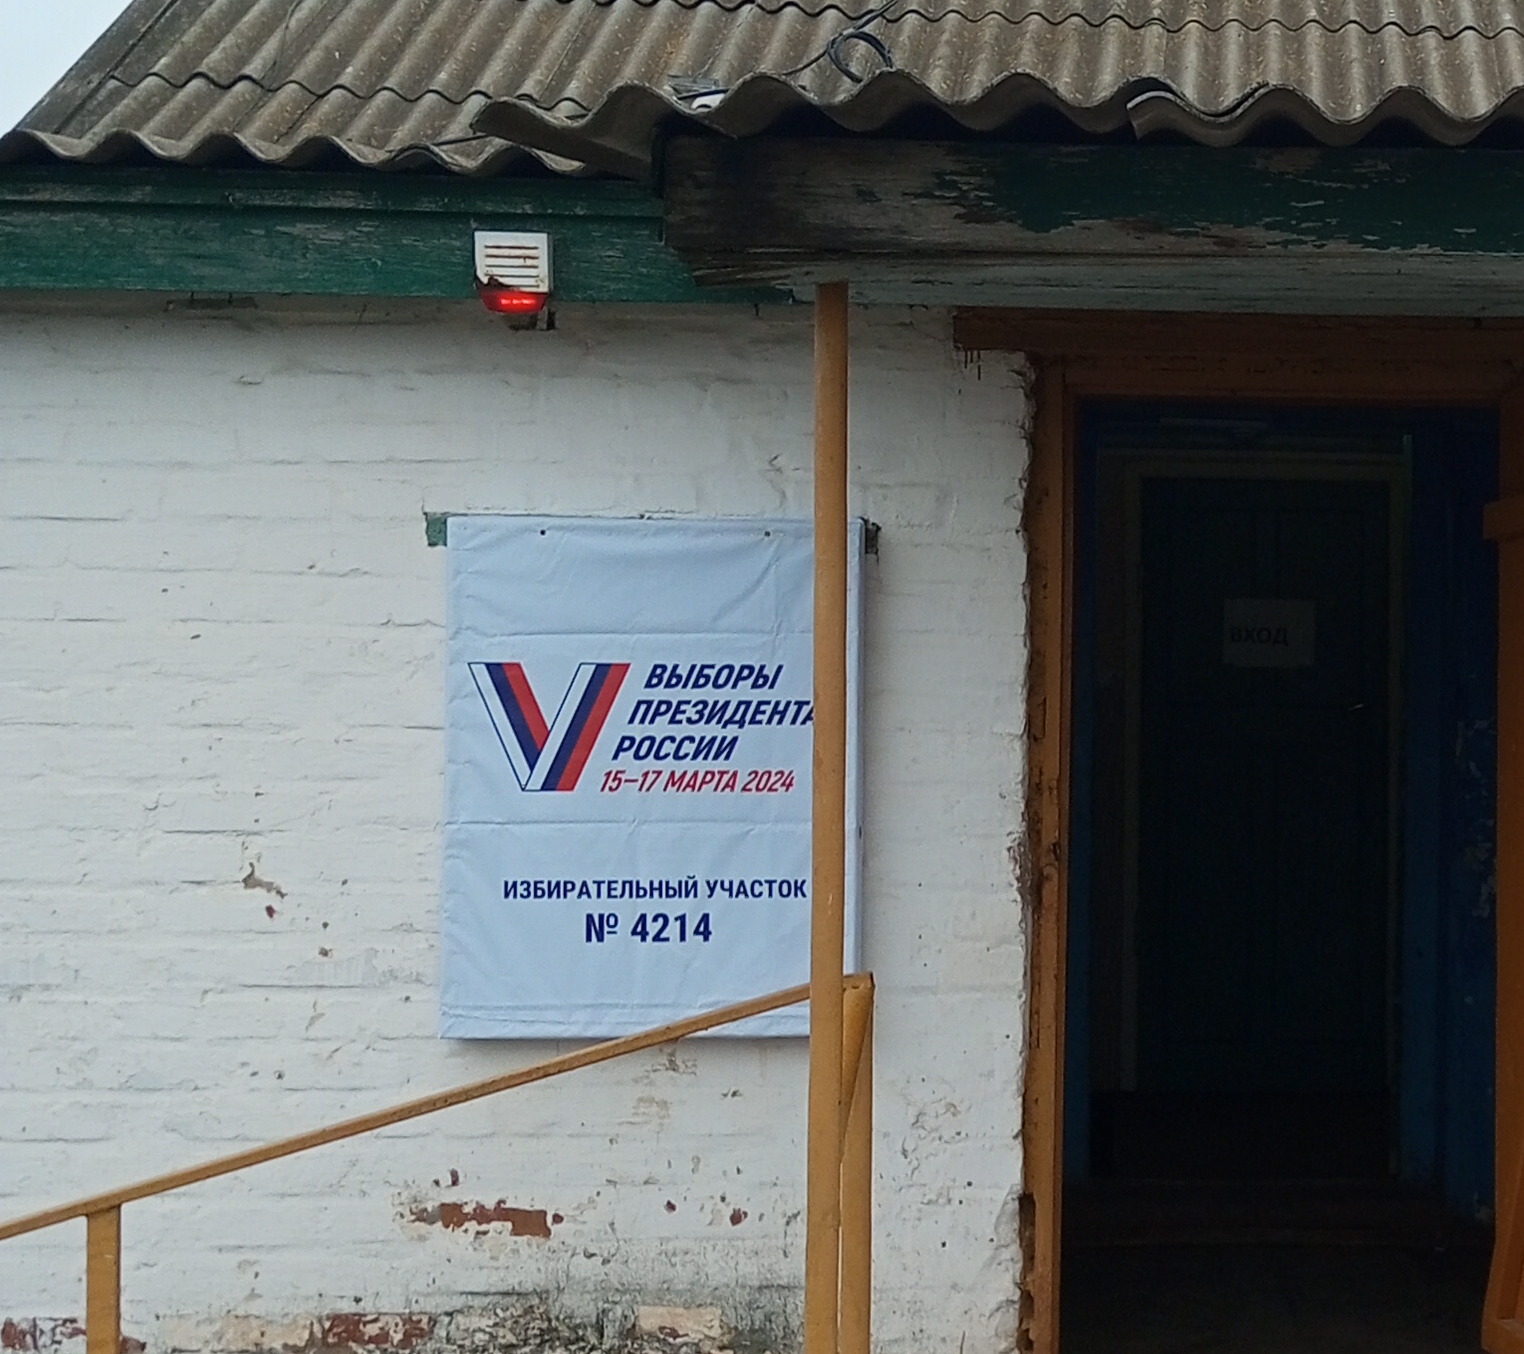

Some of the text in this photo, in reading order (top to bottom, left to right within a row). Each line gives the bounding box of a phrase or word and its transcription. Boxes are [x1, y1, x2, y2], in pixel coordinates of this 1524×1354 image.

[1230, 626, 1288, 647] ВХОД
[643, 663, 784, 691] ВЫБОРЫ
[611, 734, 740, 762] РОССИИ
[662, 769, 739, 794] МАРТА
[740, 769, 795, 794] 2024
[503, 874, 808, 900] ИЗБИРАТЕЛЬНЫЙ УЧАСТОК
[585, 912, 713, 943] № 4214
